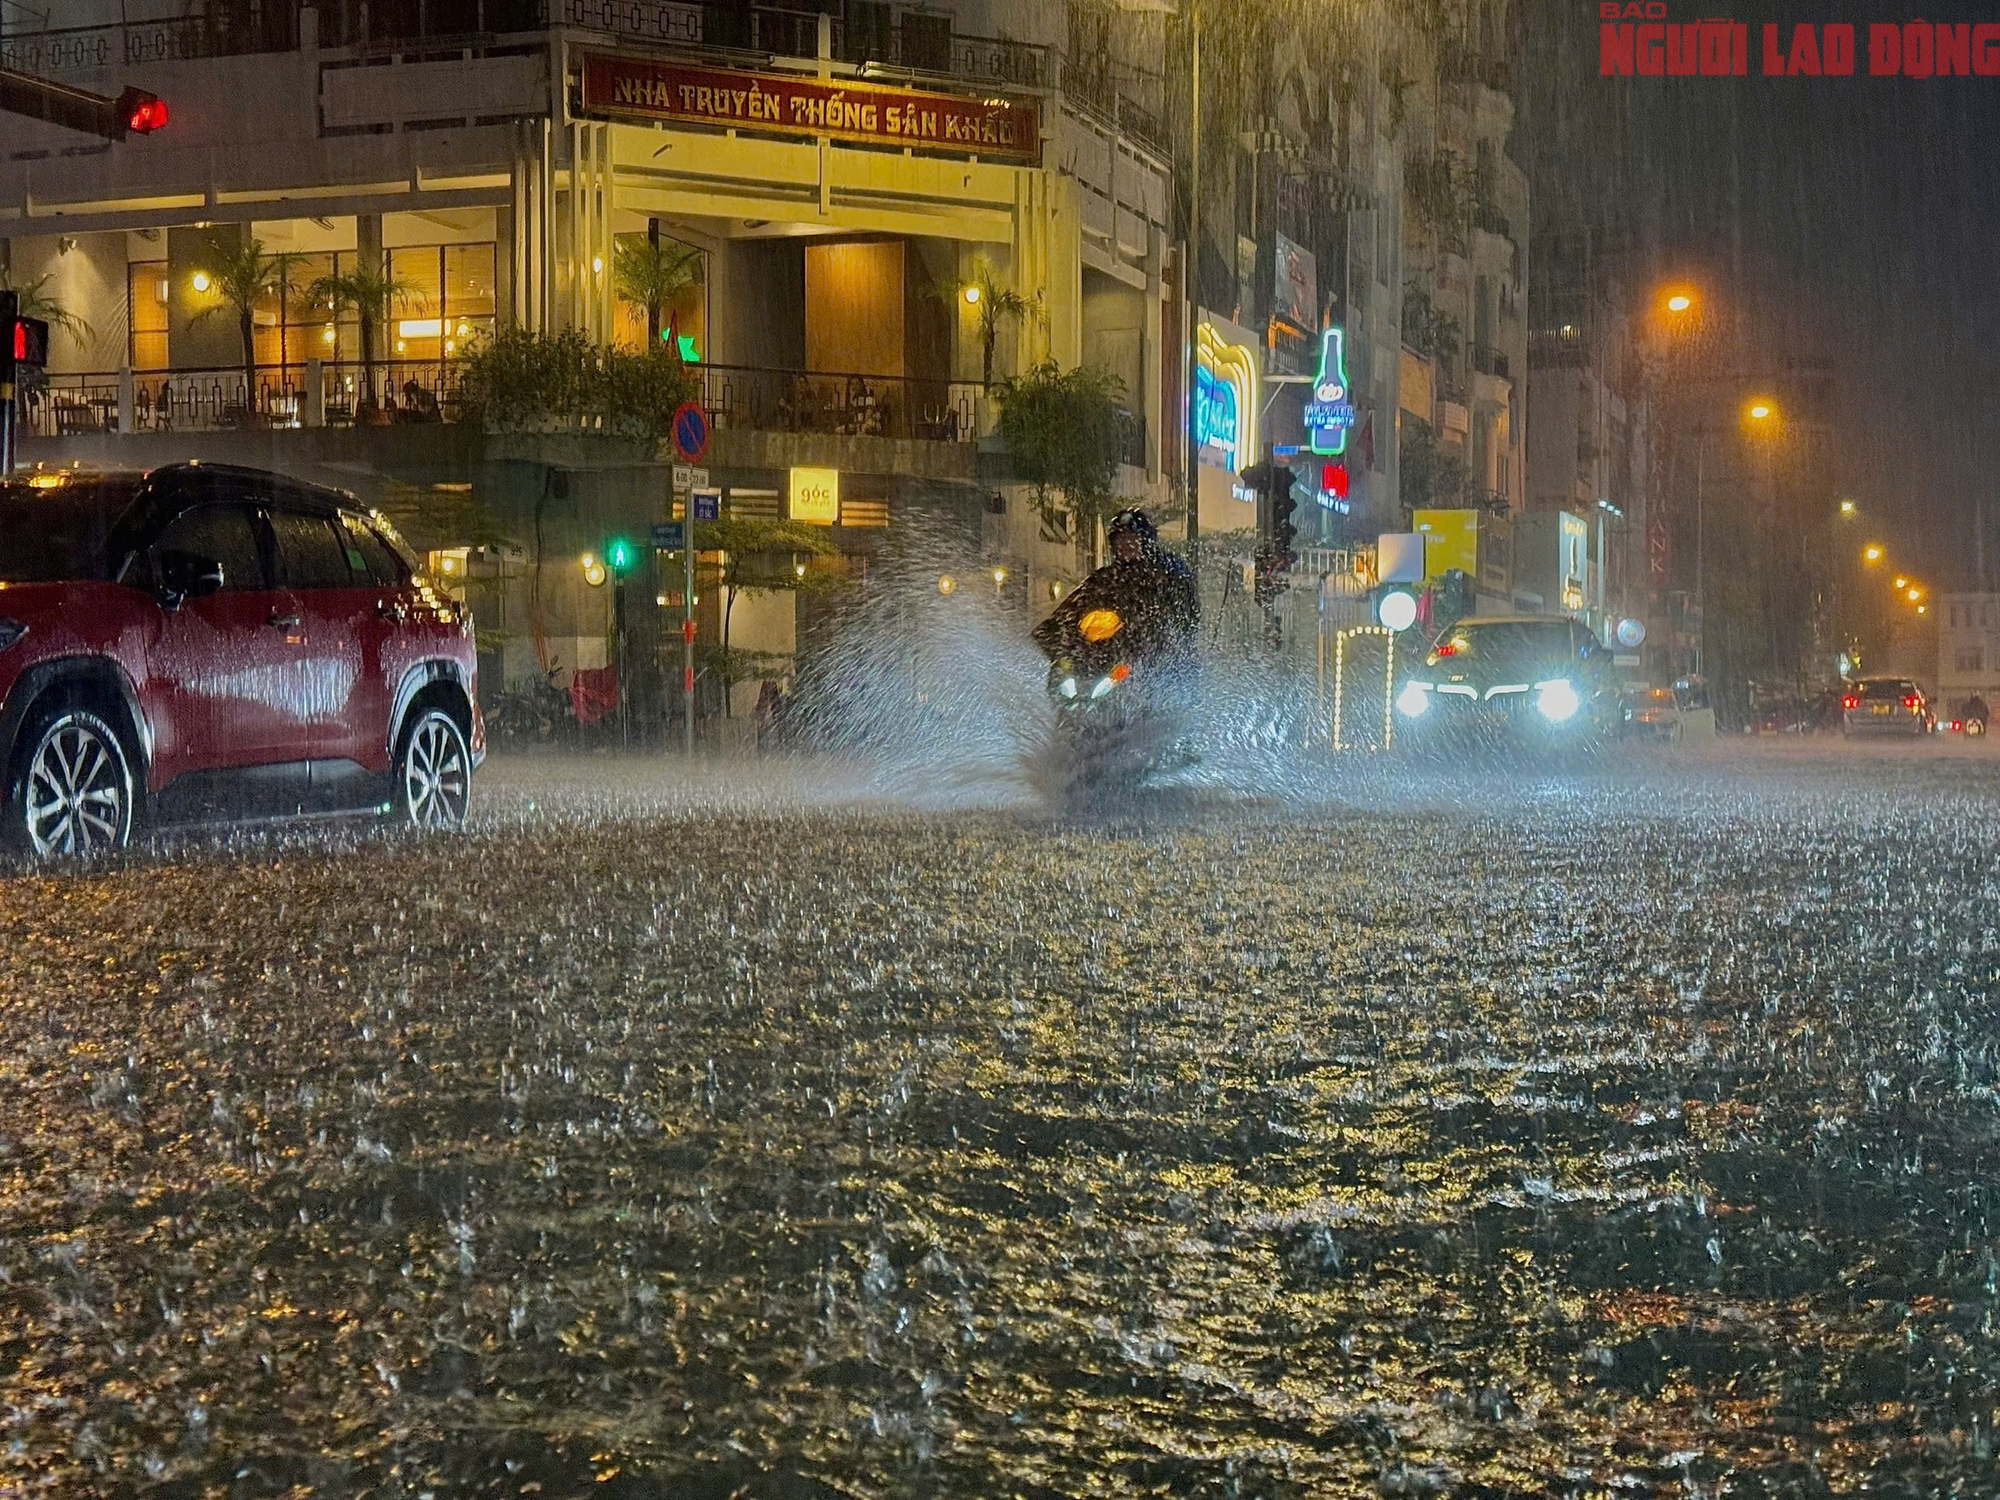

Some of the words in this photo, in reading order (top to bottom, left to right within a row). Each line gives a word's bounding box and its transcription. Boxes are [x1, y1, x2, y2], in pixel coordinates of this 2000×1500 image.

[614, 74, 670, 108] NHÀ
[678, 79, 781, 121] TRUYỀN
[790, 90, 877, 130] THỐNG
[886, 102, 938, 137] SÂN
[801, 483, 830, 502] góc
